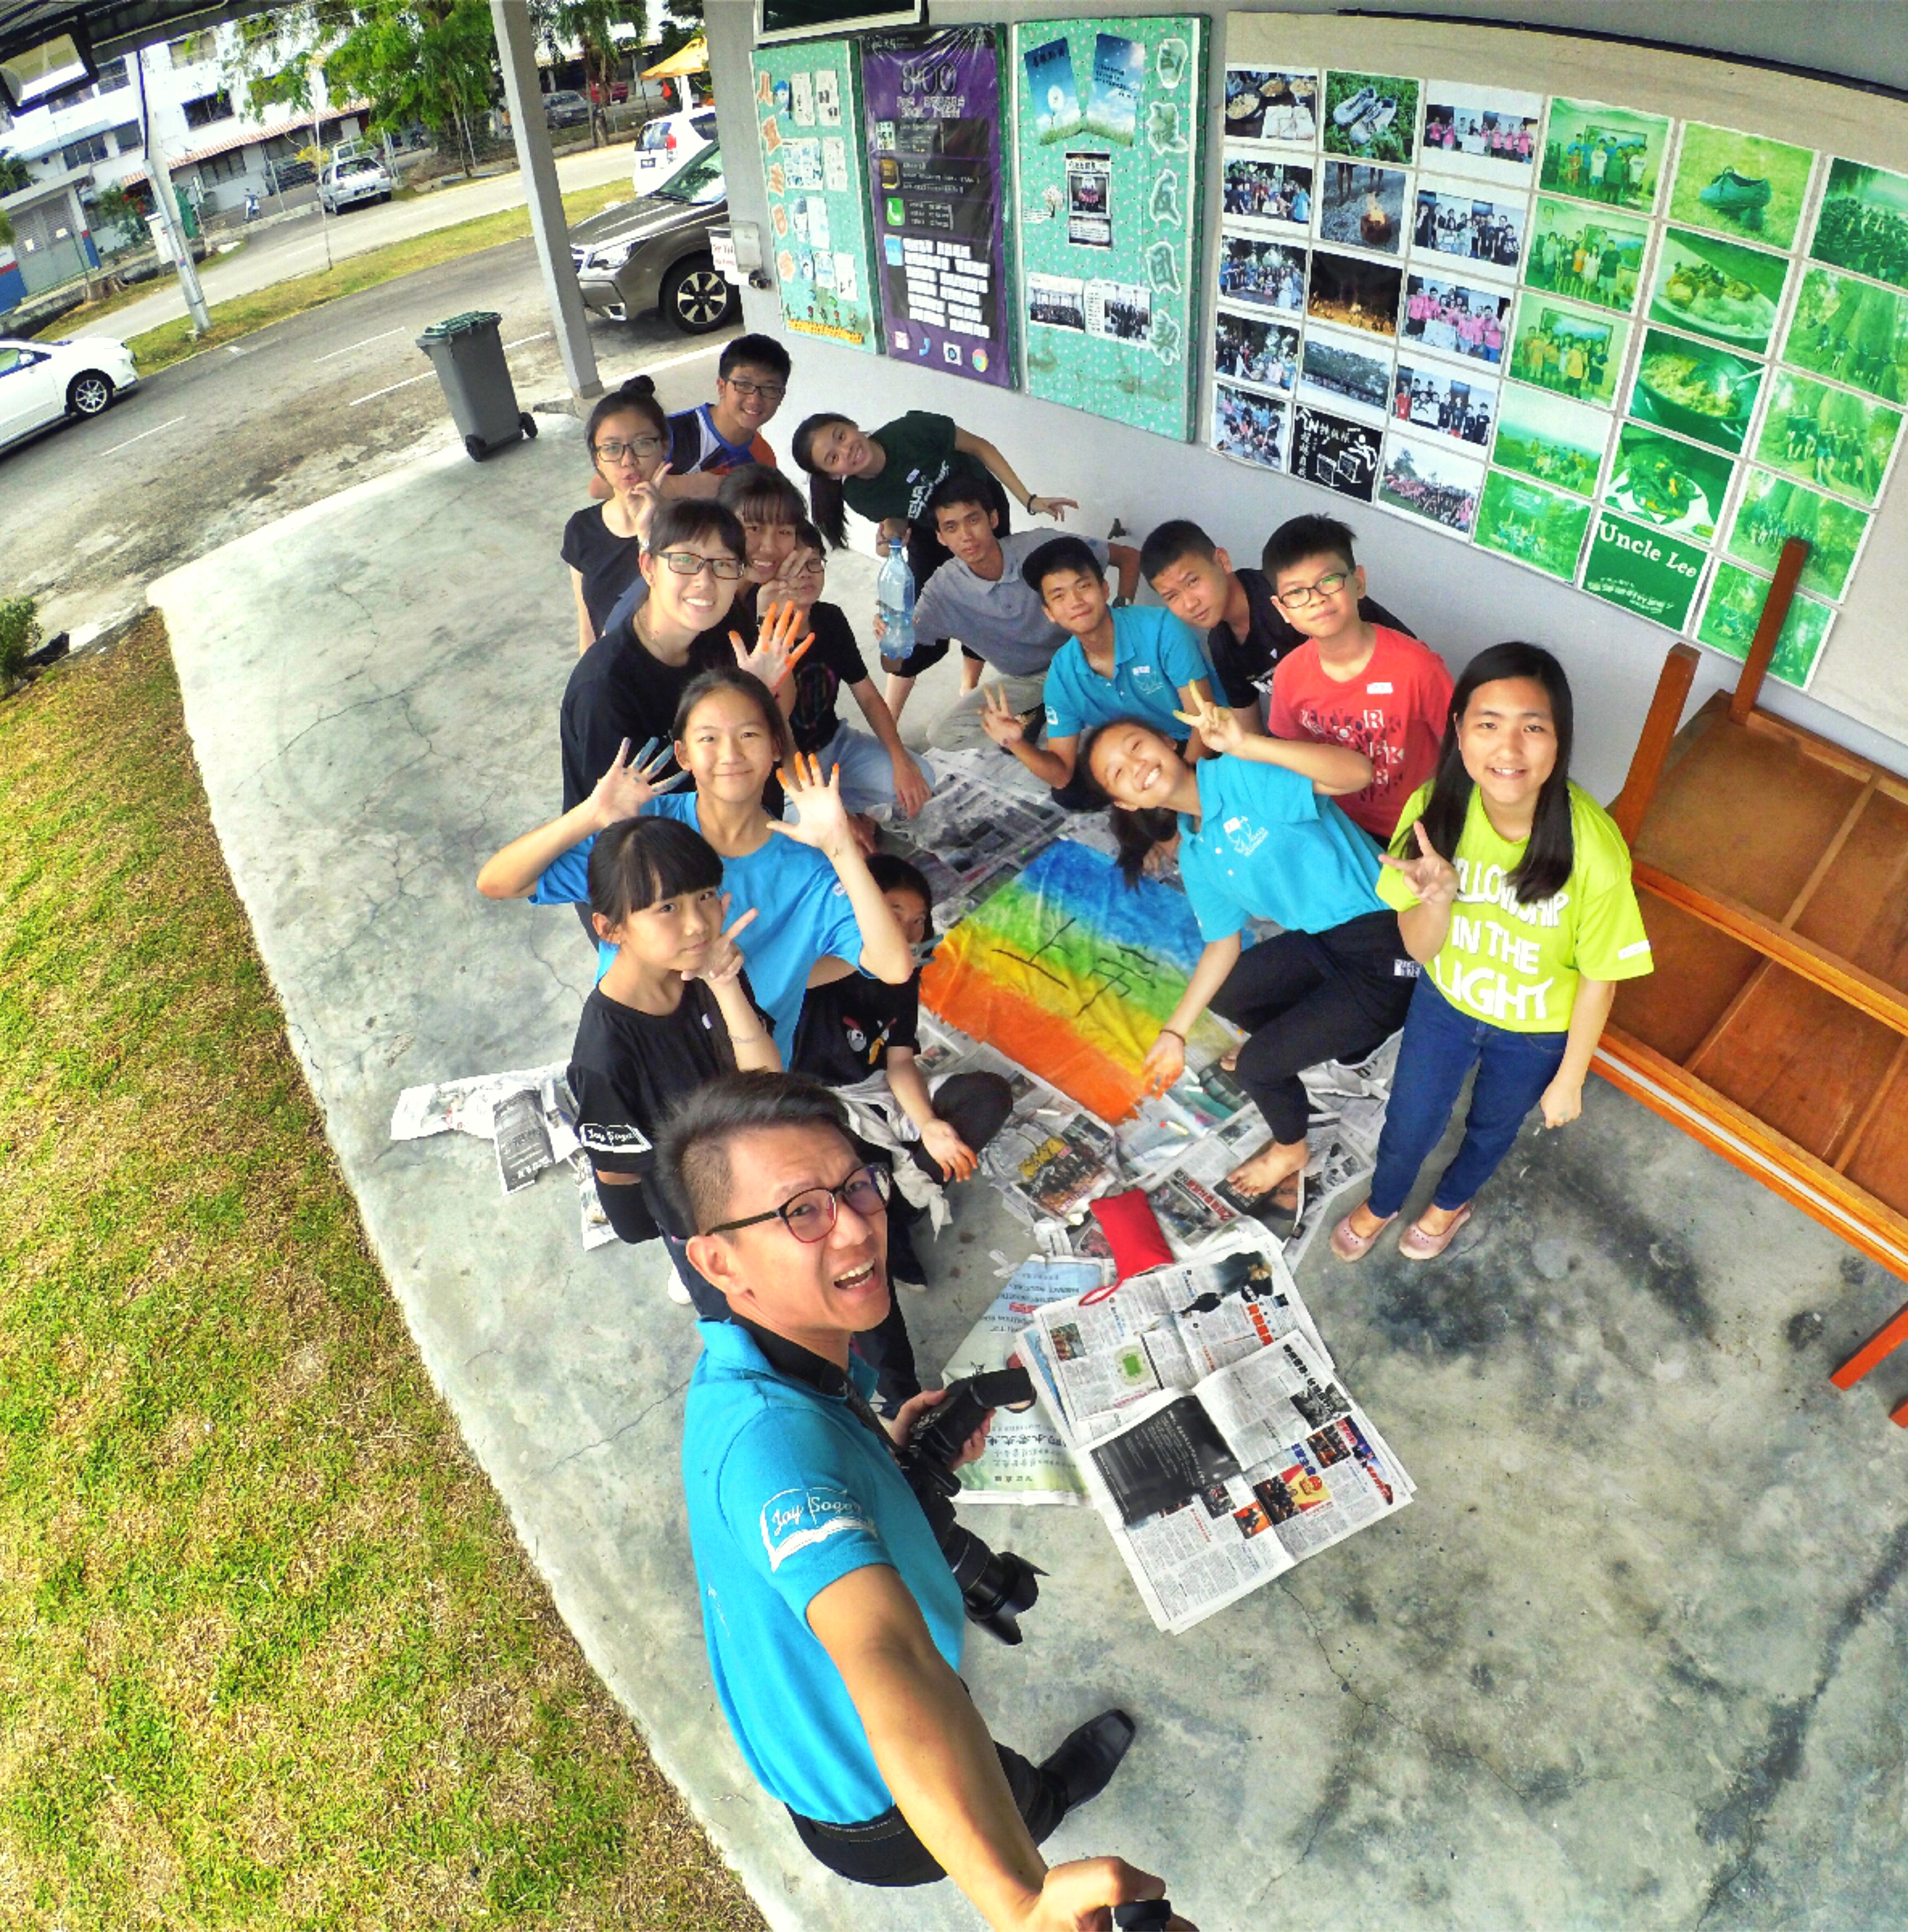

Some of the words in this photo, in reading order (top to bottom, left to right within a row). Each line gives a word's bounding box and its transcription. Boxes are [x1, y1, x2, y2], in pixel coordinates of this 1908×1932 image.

[1599, 520, 1661, 561] Uncle
[1666, 552, 1697, 578] Lee
[1452, 915, 1482, 954] IN
[1485, 920, 1541, 975] THE
[1433, 954, 1554, 1020] LIGHT
[772, 1505, 803, 1536] Joy
